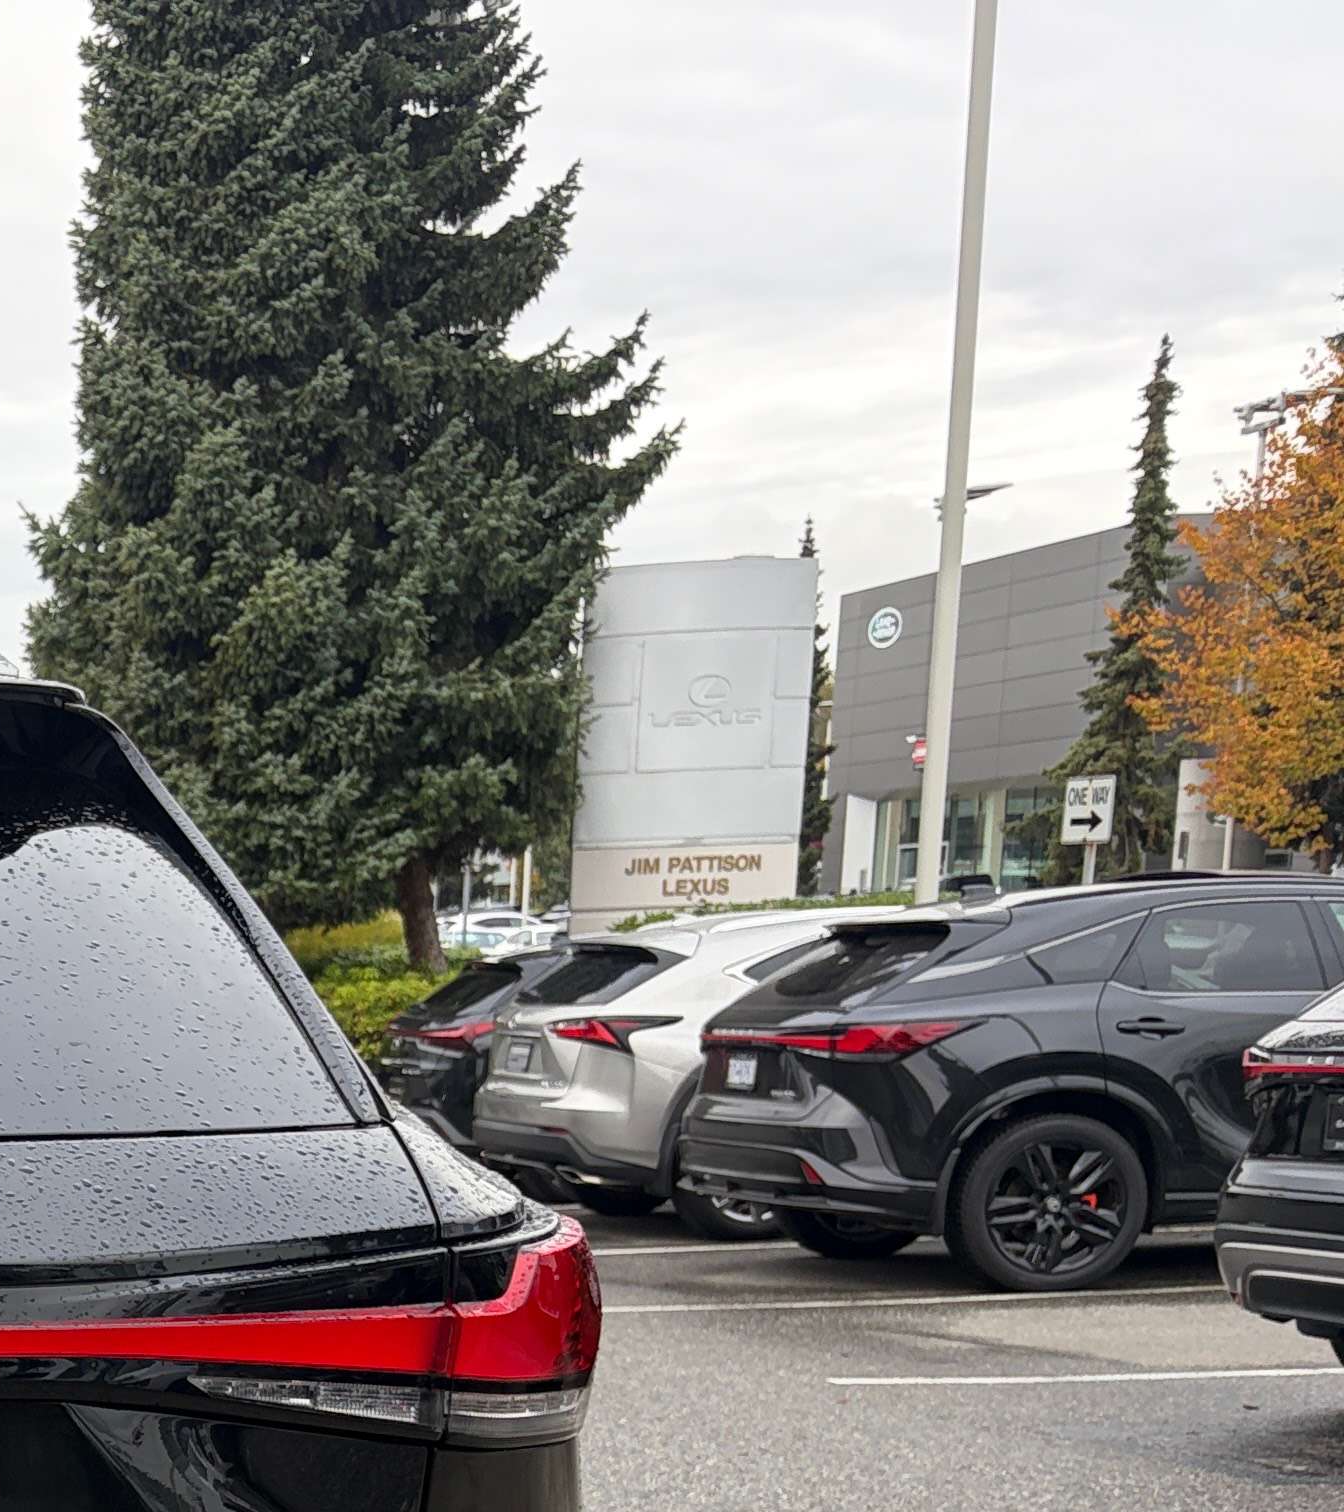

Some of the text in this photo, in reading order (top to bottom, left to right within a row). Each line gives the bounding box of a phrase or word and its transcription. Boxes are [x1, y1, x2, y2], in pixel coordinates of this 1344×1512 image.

[1068, 786, 1111, 806] ONE WAY
[624, 854, 762, 876] JIM PATTISON
[662, 878, 730, 897] LEXUS
